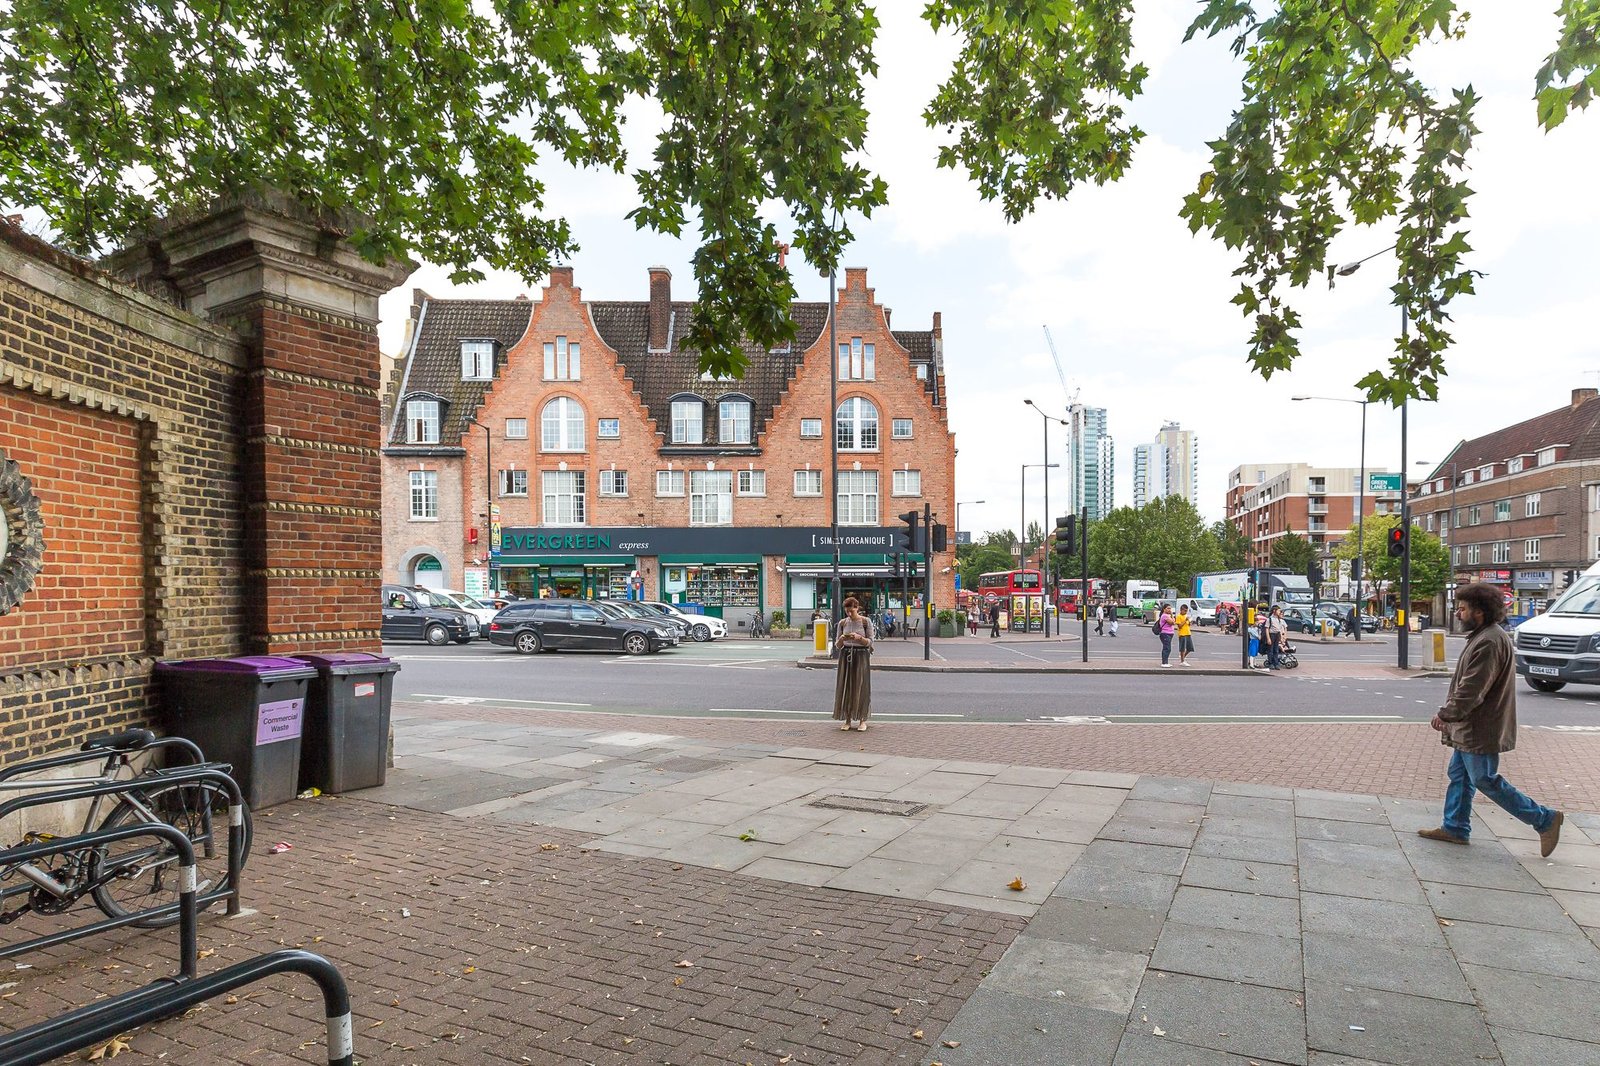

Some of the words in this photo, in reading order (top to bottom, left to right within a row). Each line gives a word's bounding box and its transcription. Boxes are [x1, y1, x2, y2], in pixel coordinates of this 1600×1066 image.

[502, 533, 611, 549] EVERGREEN
[618, 541, 649, 551] express
[820, 536, 844, 545] SIMY
[845, 536, 886, 545] ORGANIQUE
[263, 713, 298, 725] Commercial
[271, 724, 289, 732] Waste
